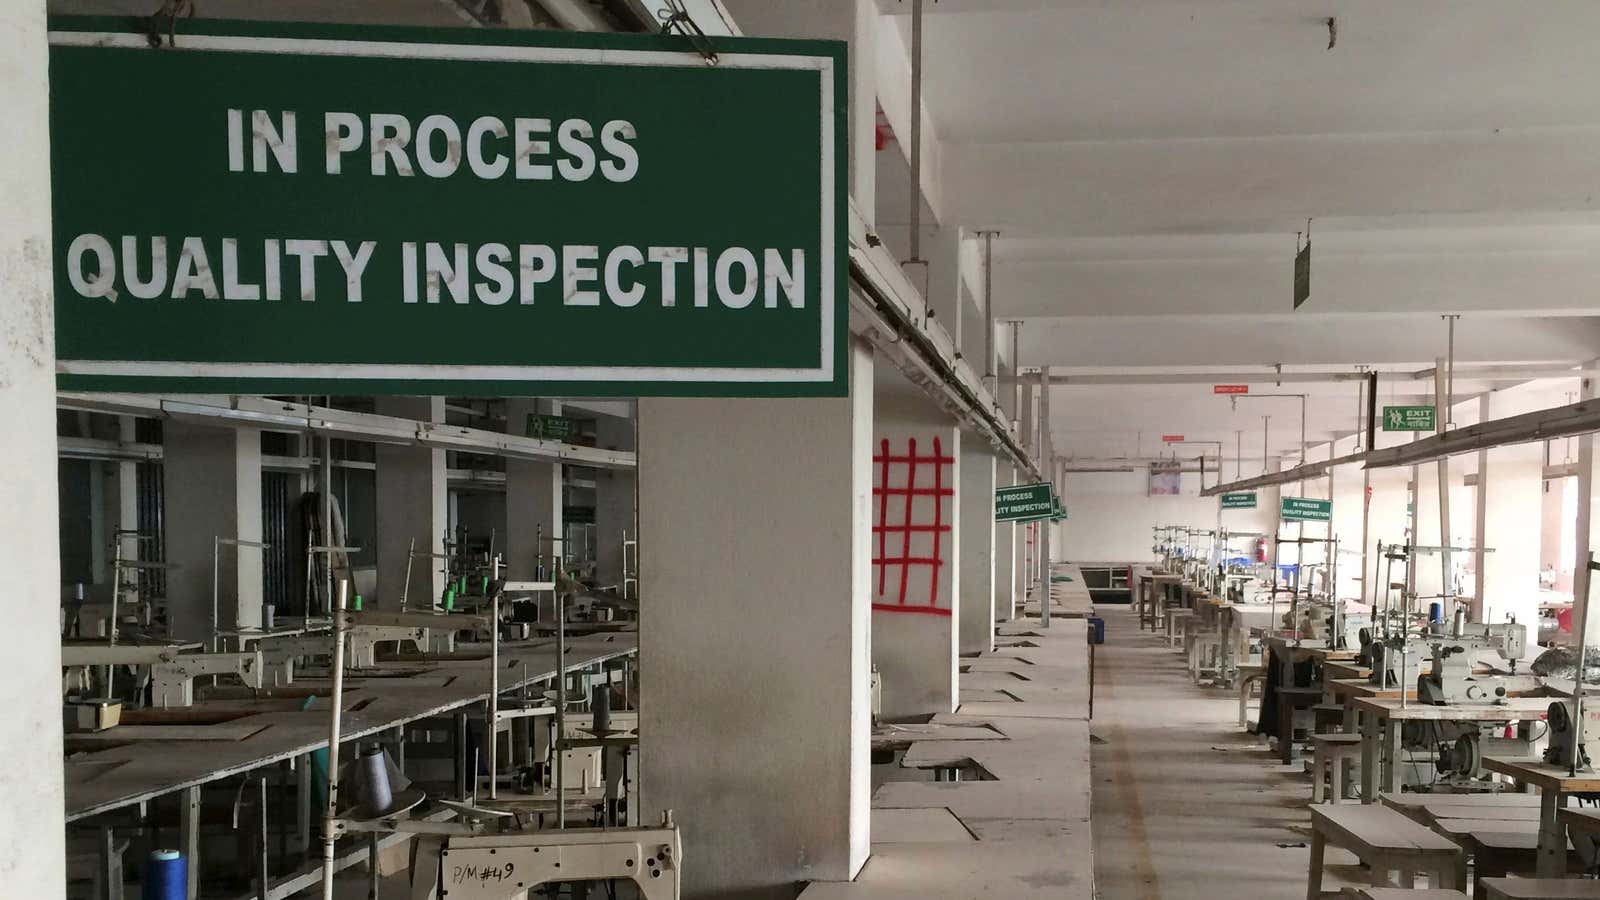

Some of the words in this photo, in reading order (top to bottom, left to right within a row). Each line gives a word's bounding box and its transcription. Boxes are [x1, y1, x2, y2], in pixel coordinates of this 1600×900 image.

[228, 109, 297, 173] IN
[325, 112, 638, 182] PROCESS
[68, 234, 376, 302] QUALITY
[403, 242, 804, 308] INSPECTION
[1003, 492, 1033, 501] PROCESS
[1011, 502, 1050, 512] INSPECTION
